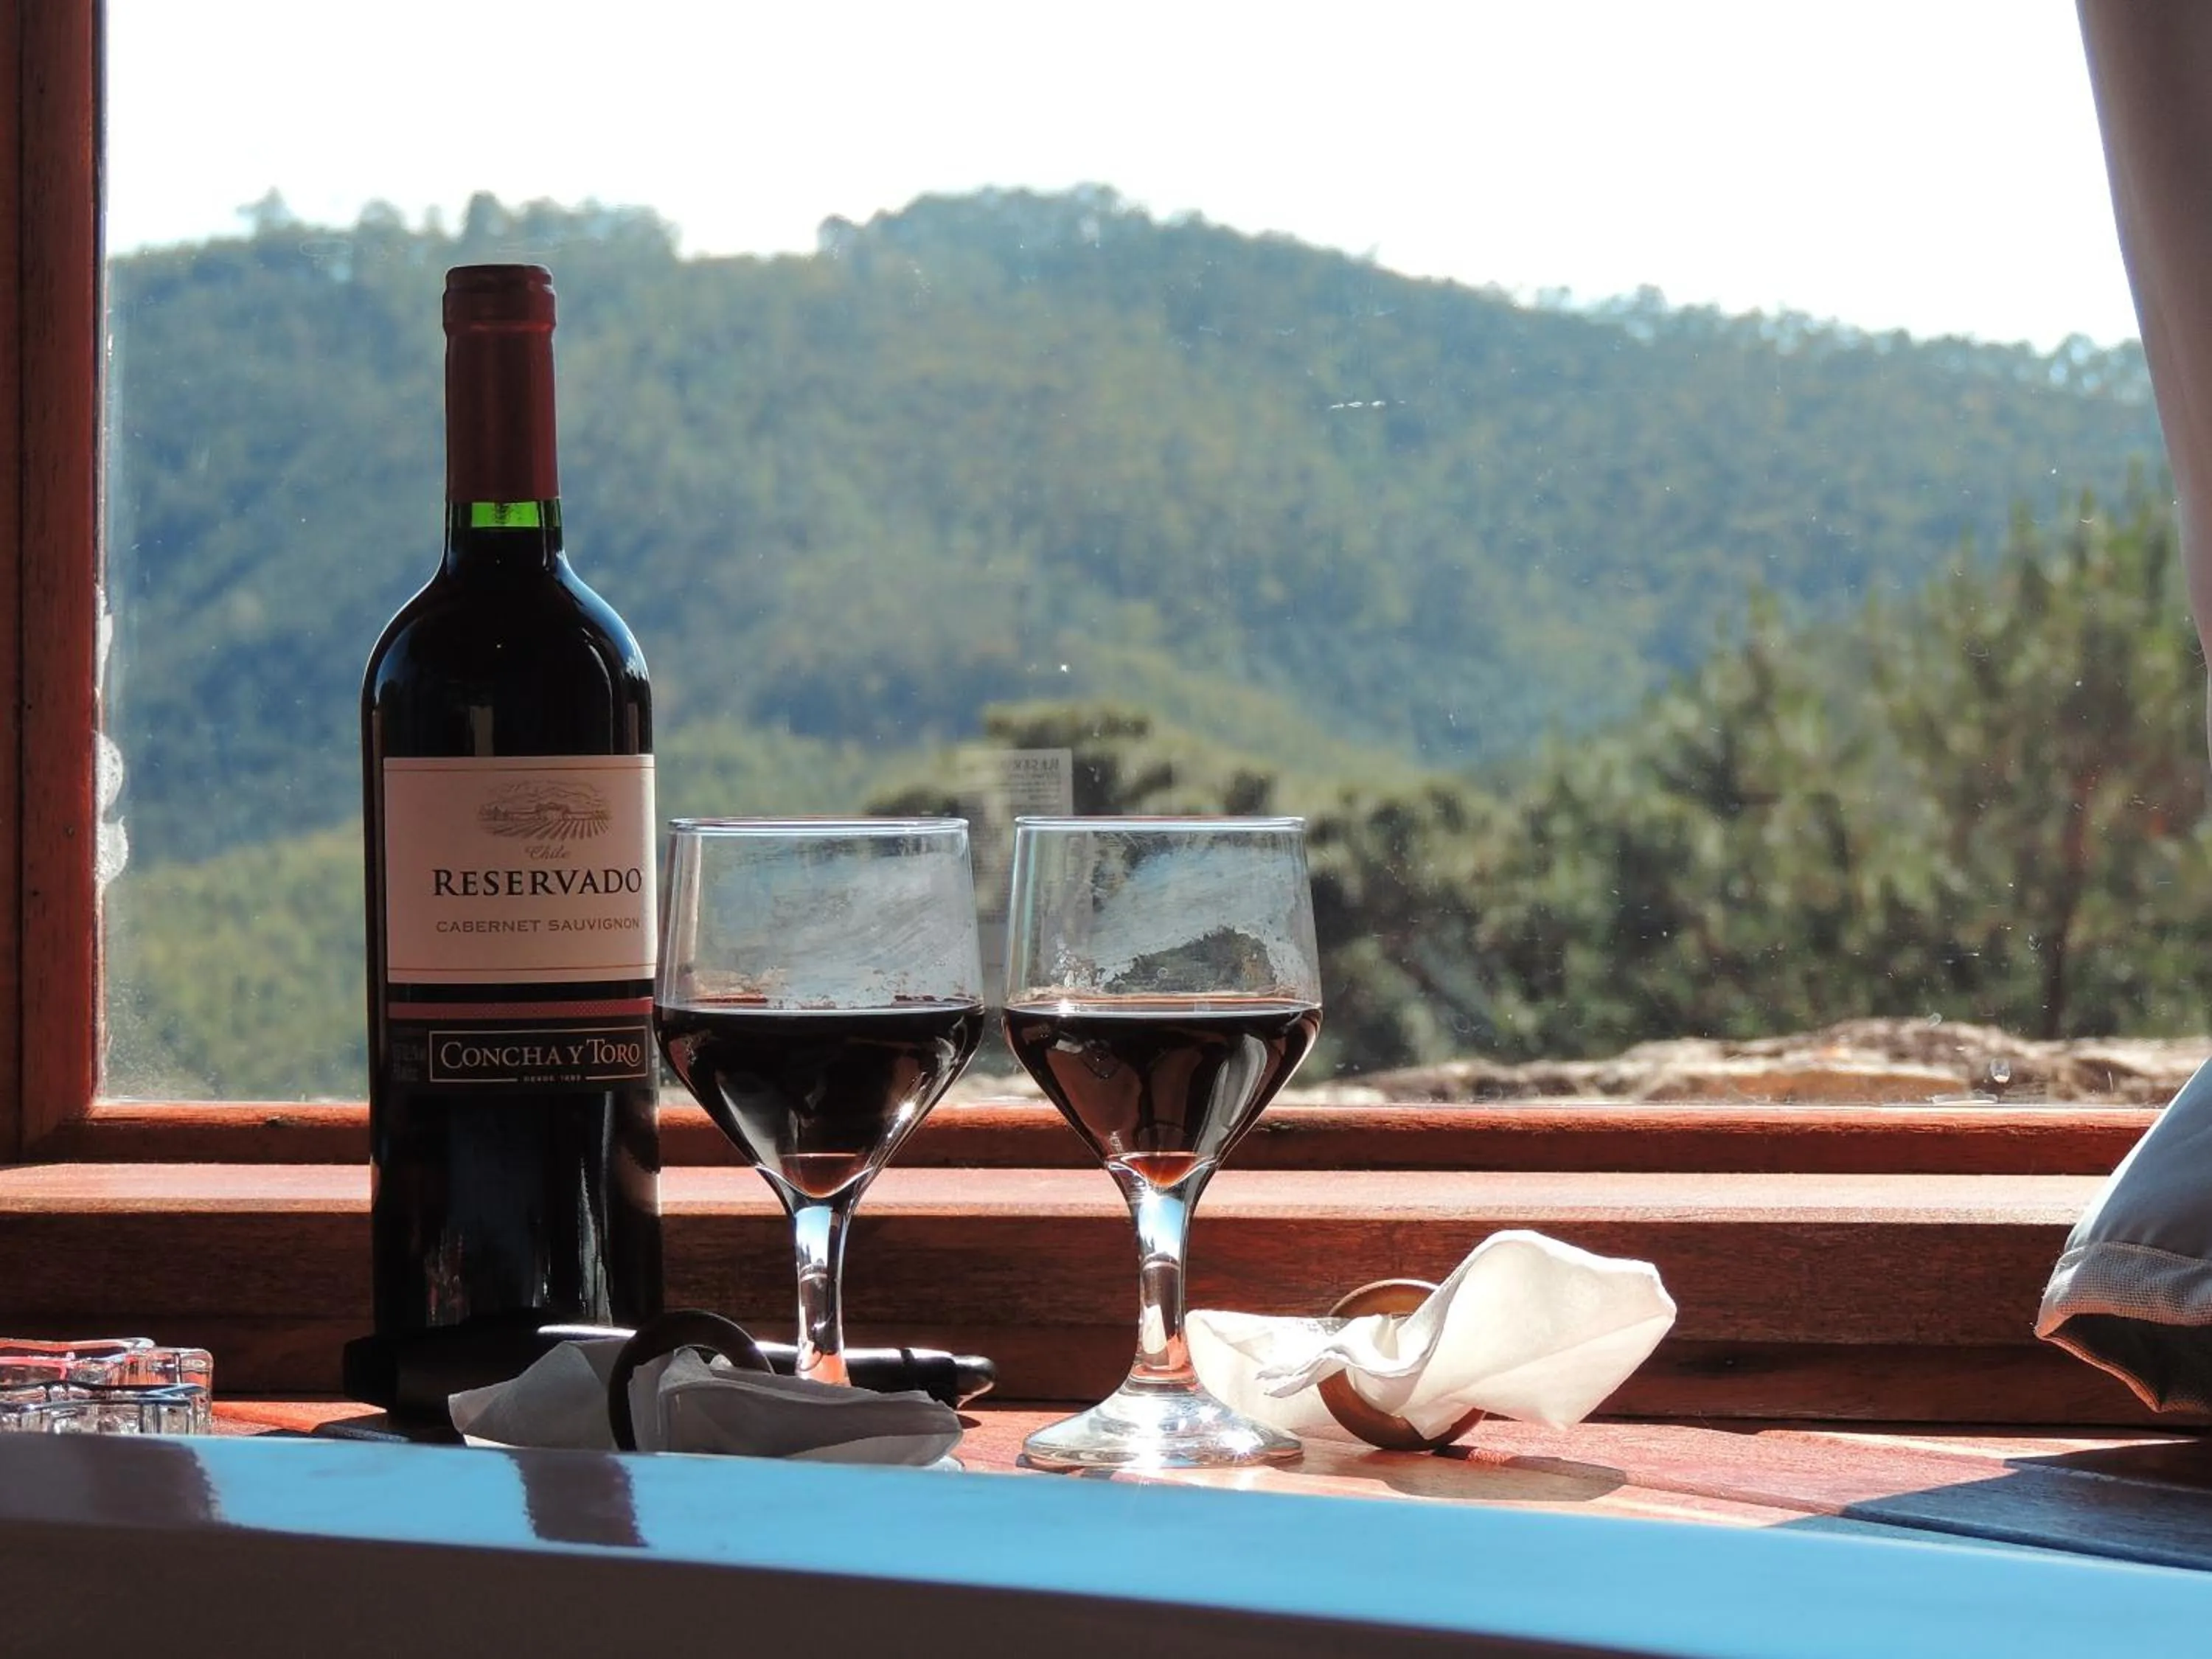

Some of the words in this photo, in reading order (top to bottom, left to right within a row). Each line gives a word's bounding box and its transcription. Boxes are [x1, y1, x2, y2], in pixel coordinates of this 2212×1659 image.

[524, 844, 571, 860] Chile
[432, 867, 643, 897] RESERVADO
[436, 919, 542, 933] CABERNET
[548, 917, 640, 932] SAUVIGNON
[440, 1040, 562, 1070] CONCHA
[566, 1044, 585, 1065] Y
[586, 1037, 641, 1068] TORO
